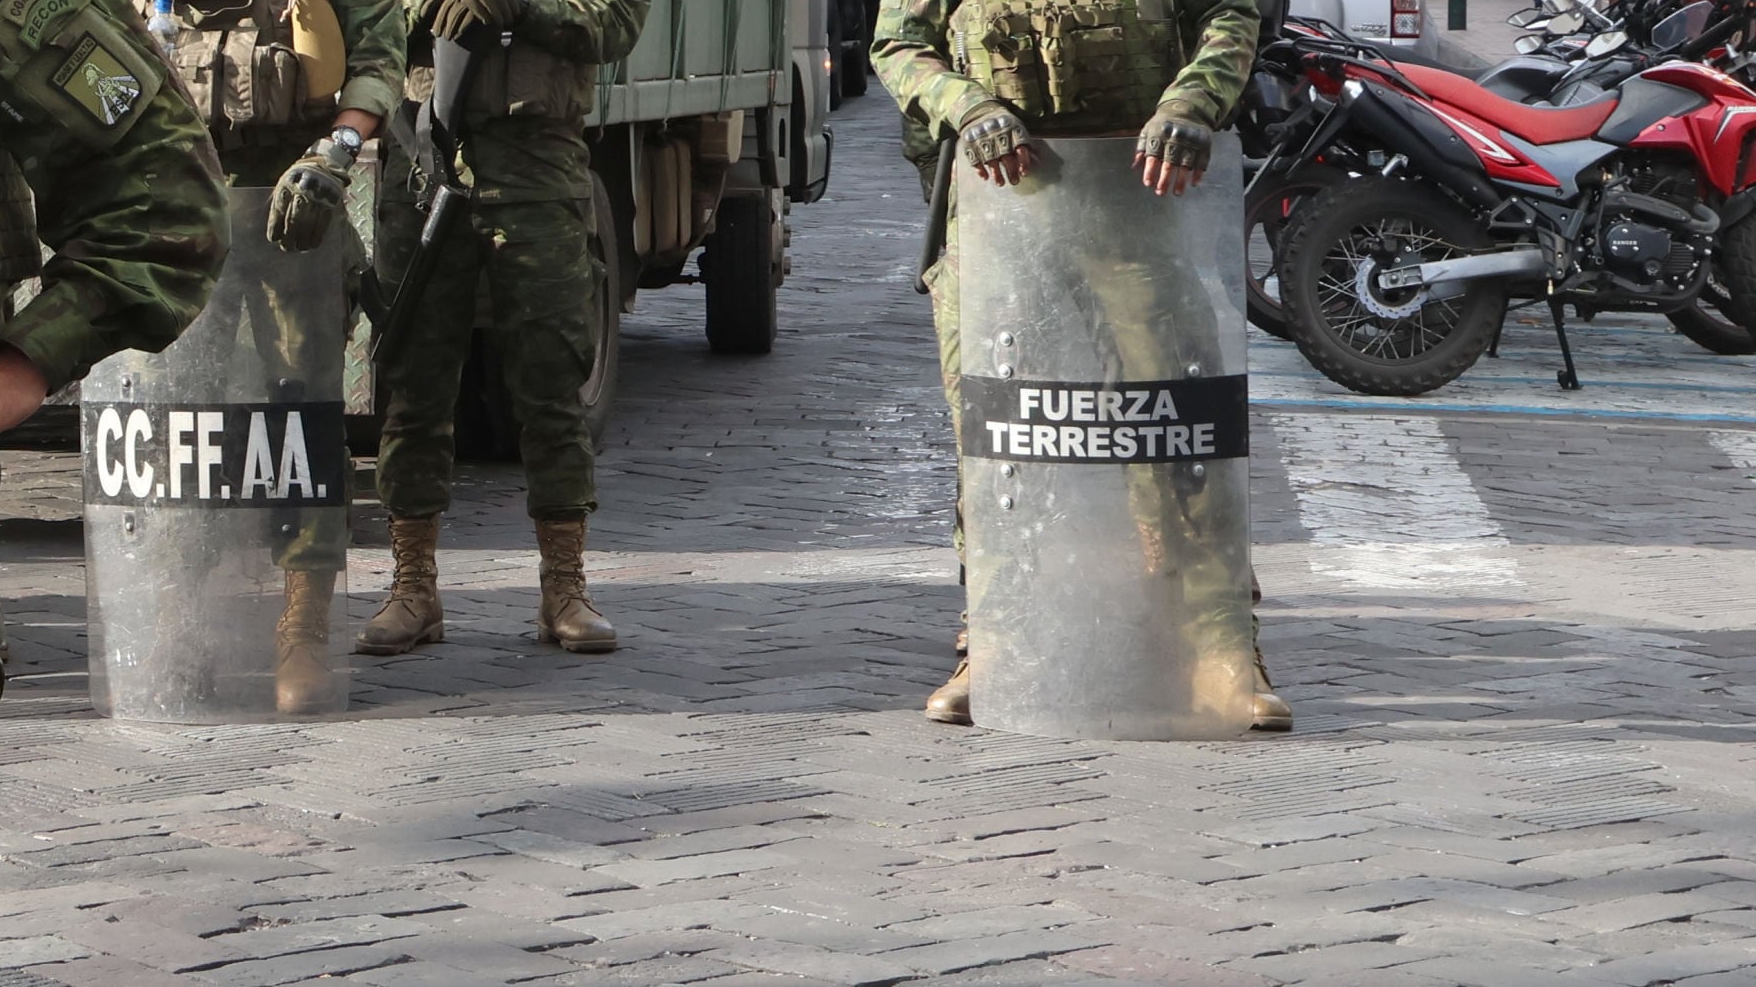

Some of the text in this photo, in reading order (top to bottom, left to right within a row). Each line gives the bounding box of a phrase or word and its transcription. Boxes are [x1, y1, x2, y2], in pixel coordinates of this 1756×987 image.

[1019, 388, 1179, 422] FUERZA
[96, 407, 327, 500] CC.FF.AA.
[985, 420, 1216, 458] TERRESTRE
